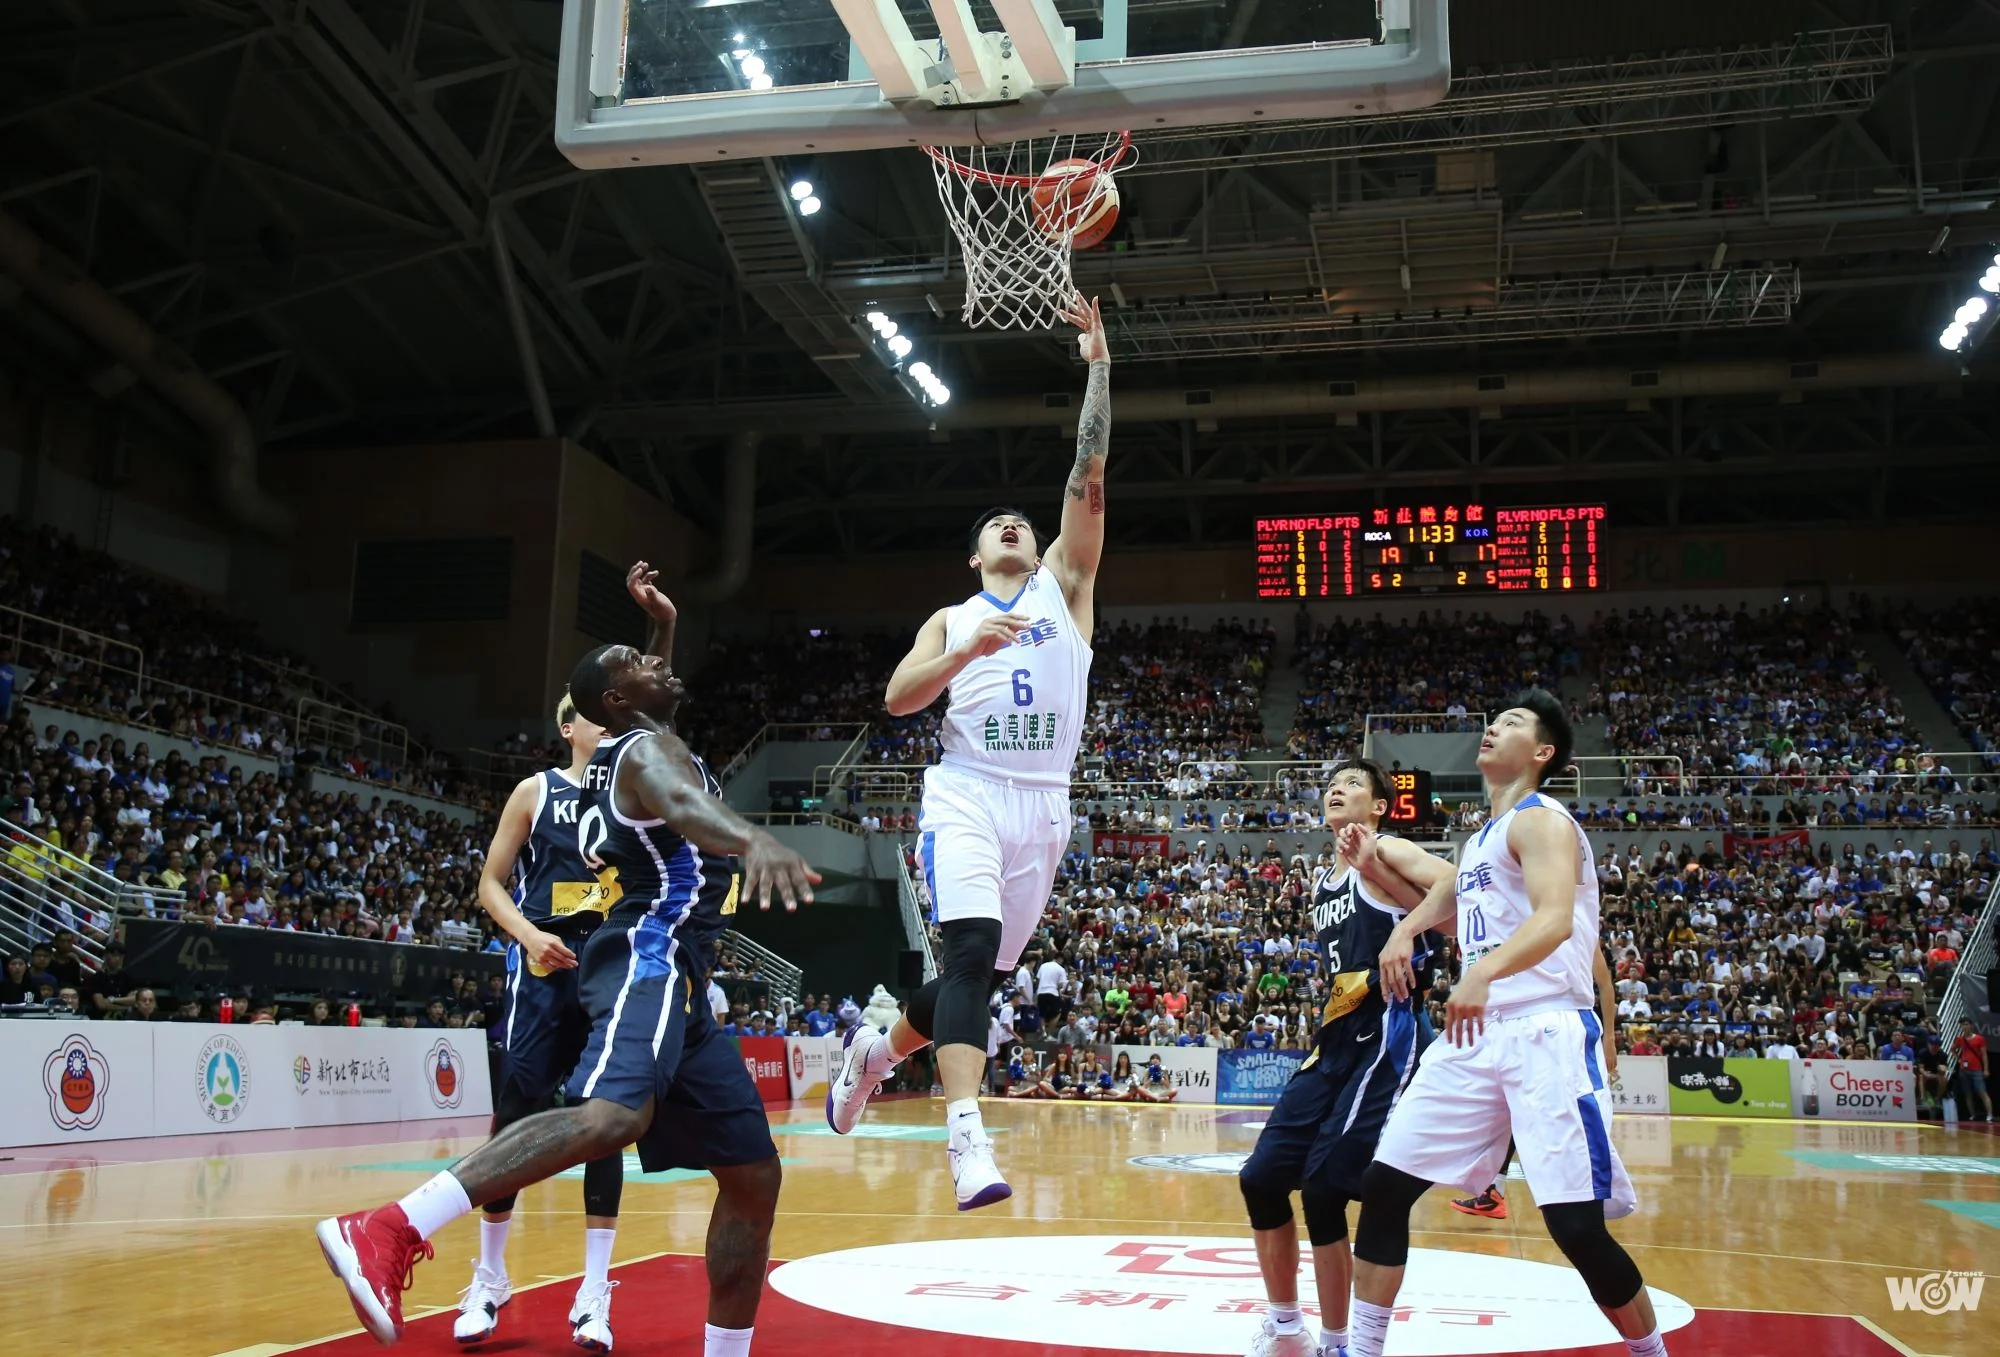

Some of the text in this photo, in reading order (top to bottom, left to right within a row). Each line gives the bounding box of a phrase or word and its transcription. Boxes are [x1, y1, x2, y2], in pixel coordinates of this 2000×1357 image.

[1257, 516, 1360, 532] PLYR NO FLS PTS
[1497, 507, 1605, 523] PLYR NO FLS PTS
[1465, 528, 1489, 537] KOR
[1381, 546, 1400, 564] 19
[1428, 550, 1434, 563] 1
[1478, 543, 1497, 561] 17
[1371, 573, 1381, 588] 5
[1392, 573, 1402, 587] 2
[1457, 571, 1467, 585] 2
[1486, 570, 1497, 585] 5
[1011, 668, 1034, 707] 6
[984, 740, 1054, 752] TAIWAN BEER
[1466, 903, 1486, 945] 10
[1328, 939, 1342, 974] 5
[213, 1037, 225, 1049] OF
[317, 1056, 390, 1086] 新北市政府
[1830, 1070, 1905, 1093] Cheers
[1836, 1094, 1887, 1108] BODY
